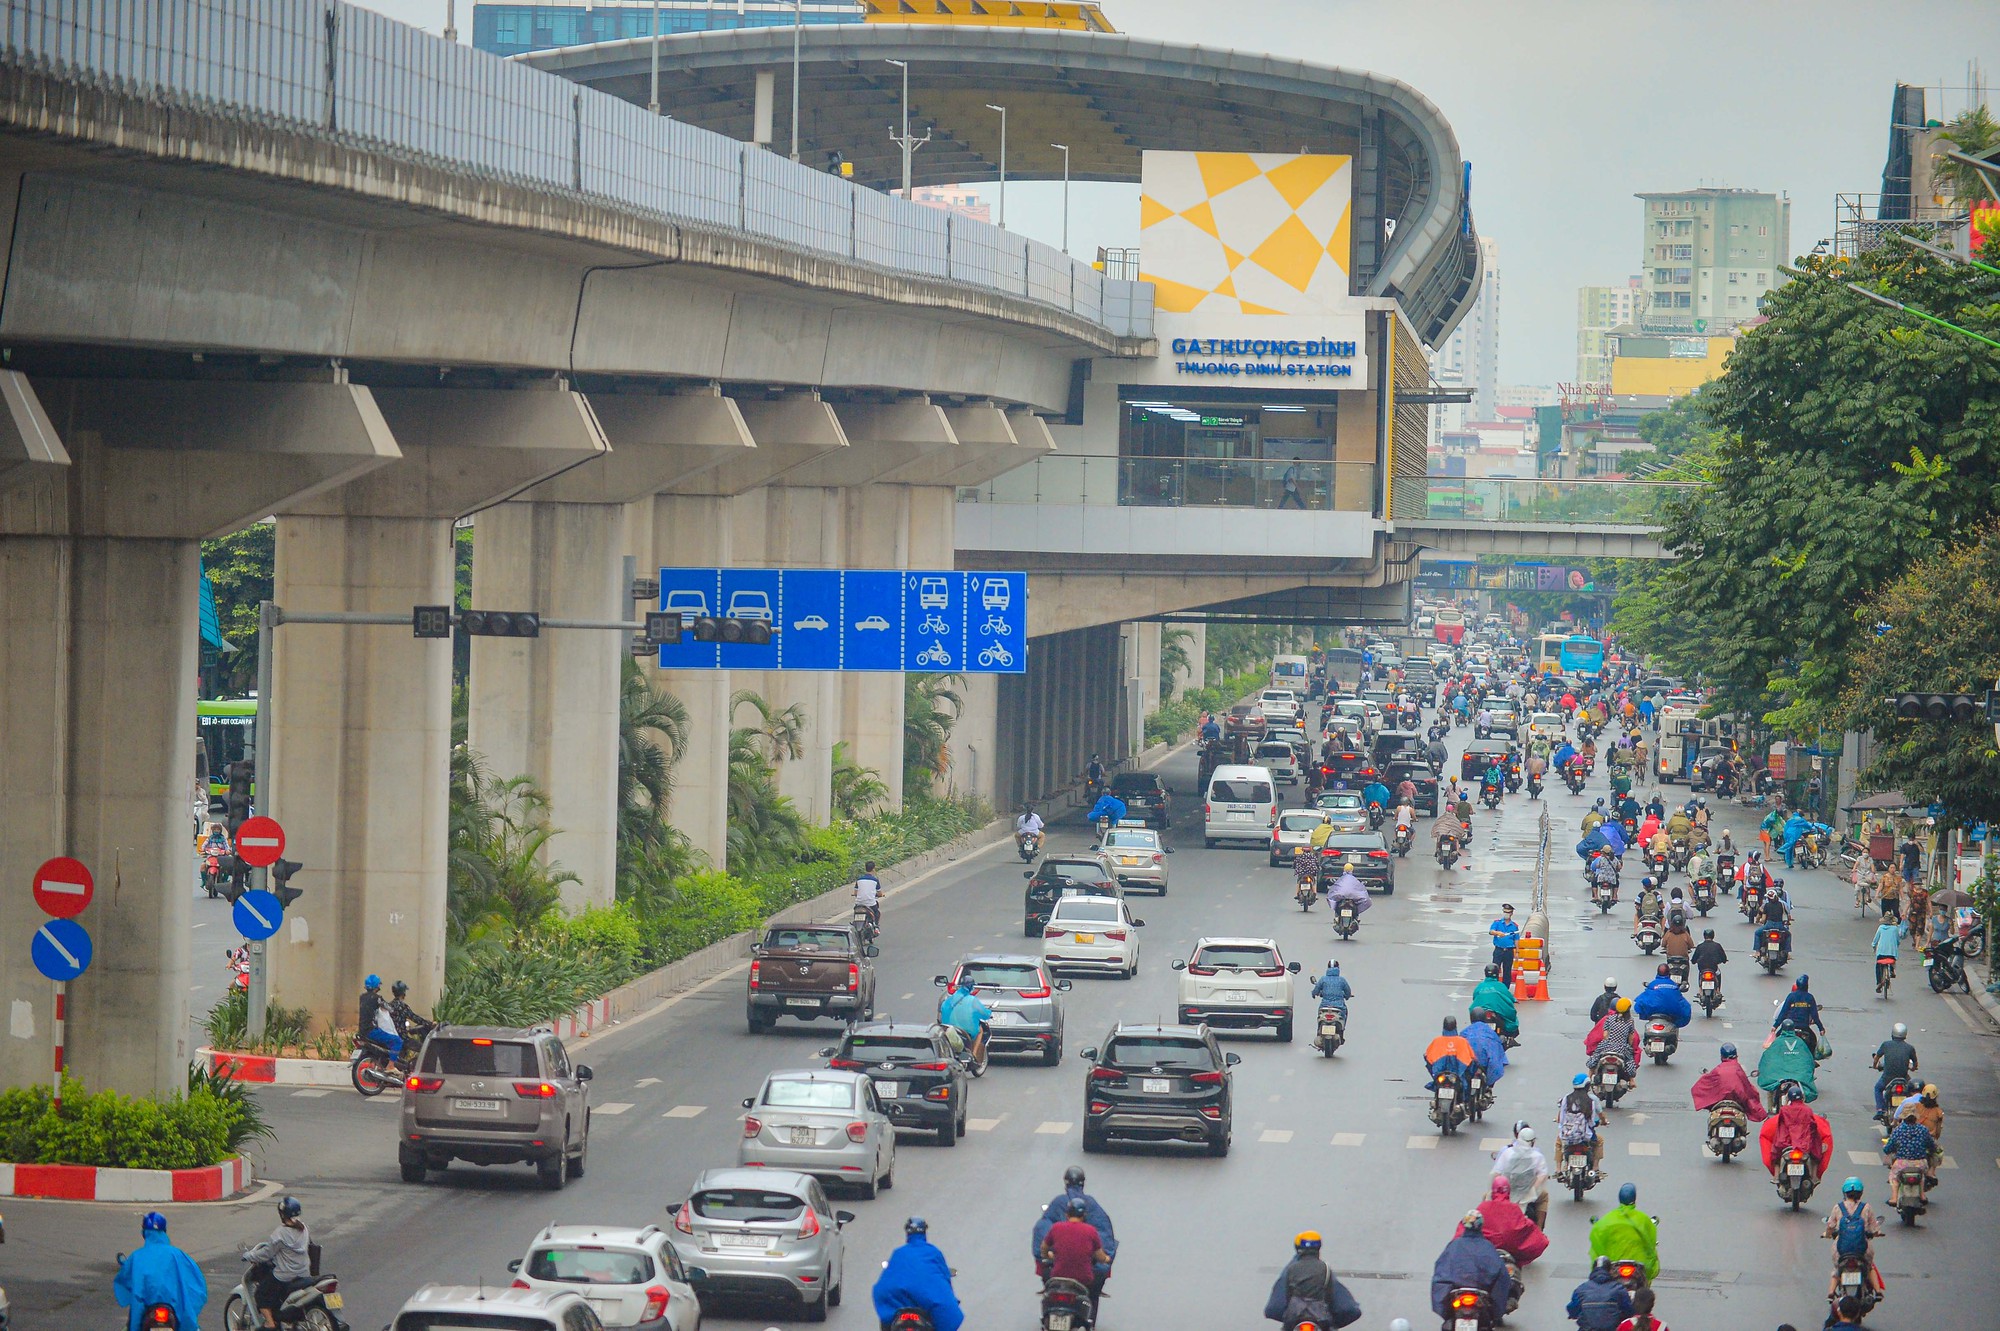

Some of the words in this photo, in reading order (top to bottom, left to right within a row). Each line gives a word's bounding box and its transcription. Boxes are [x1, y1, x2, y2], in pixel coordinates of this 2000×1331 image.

[1640, 323, 1693, 333] Vietcombank
[1172, 338, 1201, 354] GA
[1205, 339, 1299, 359] THƯỢNG
[1306, 336, 1356, 357] ĐÌNH
[1175, 362, 1239, 375] THUONG
[1246, 363, 1281, 375] DINH
[1287, 364, 1351, 377] STATION
[1557, 382, 1582, 396] Nhà
[1585, 383, 1613, 397] Sách
[202, 717, 211, 726] E01
[797, 1128, 810, 1136] 30A
